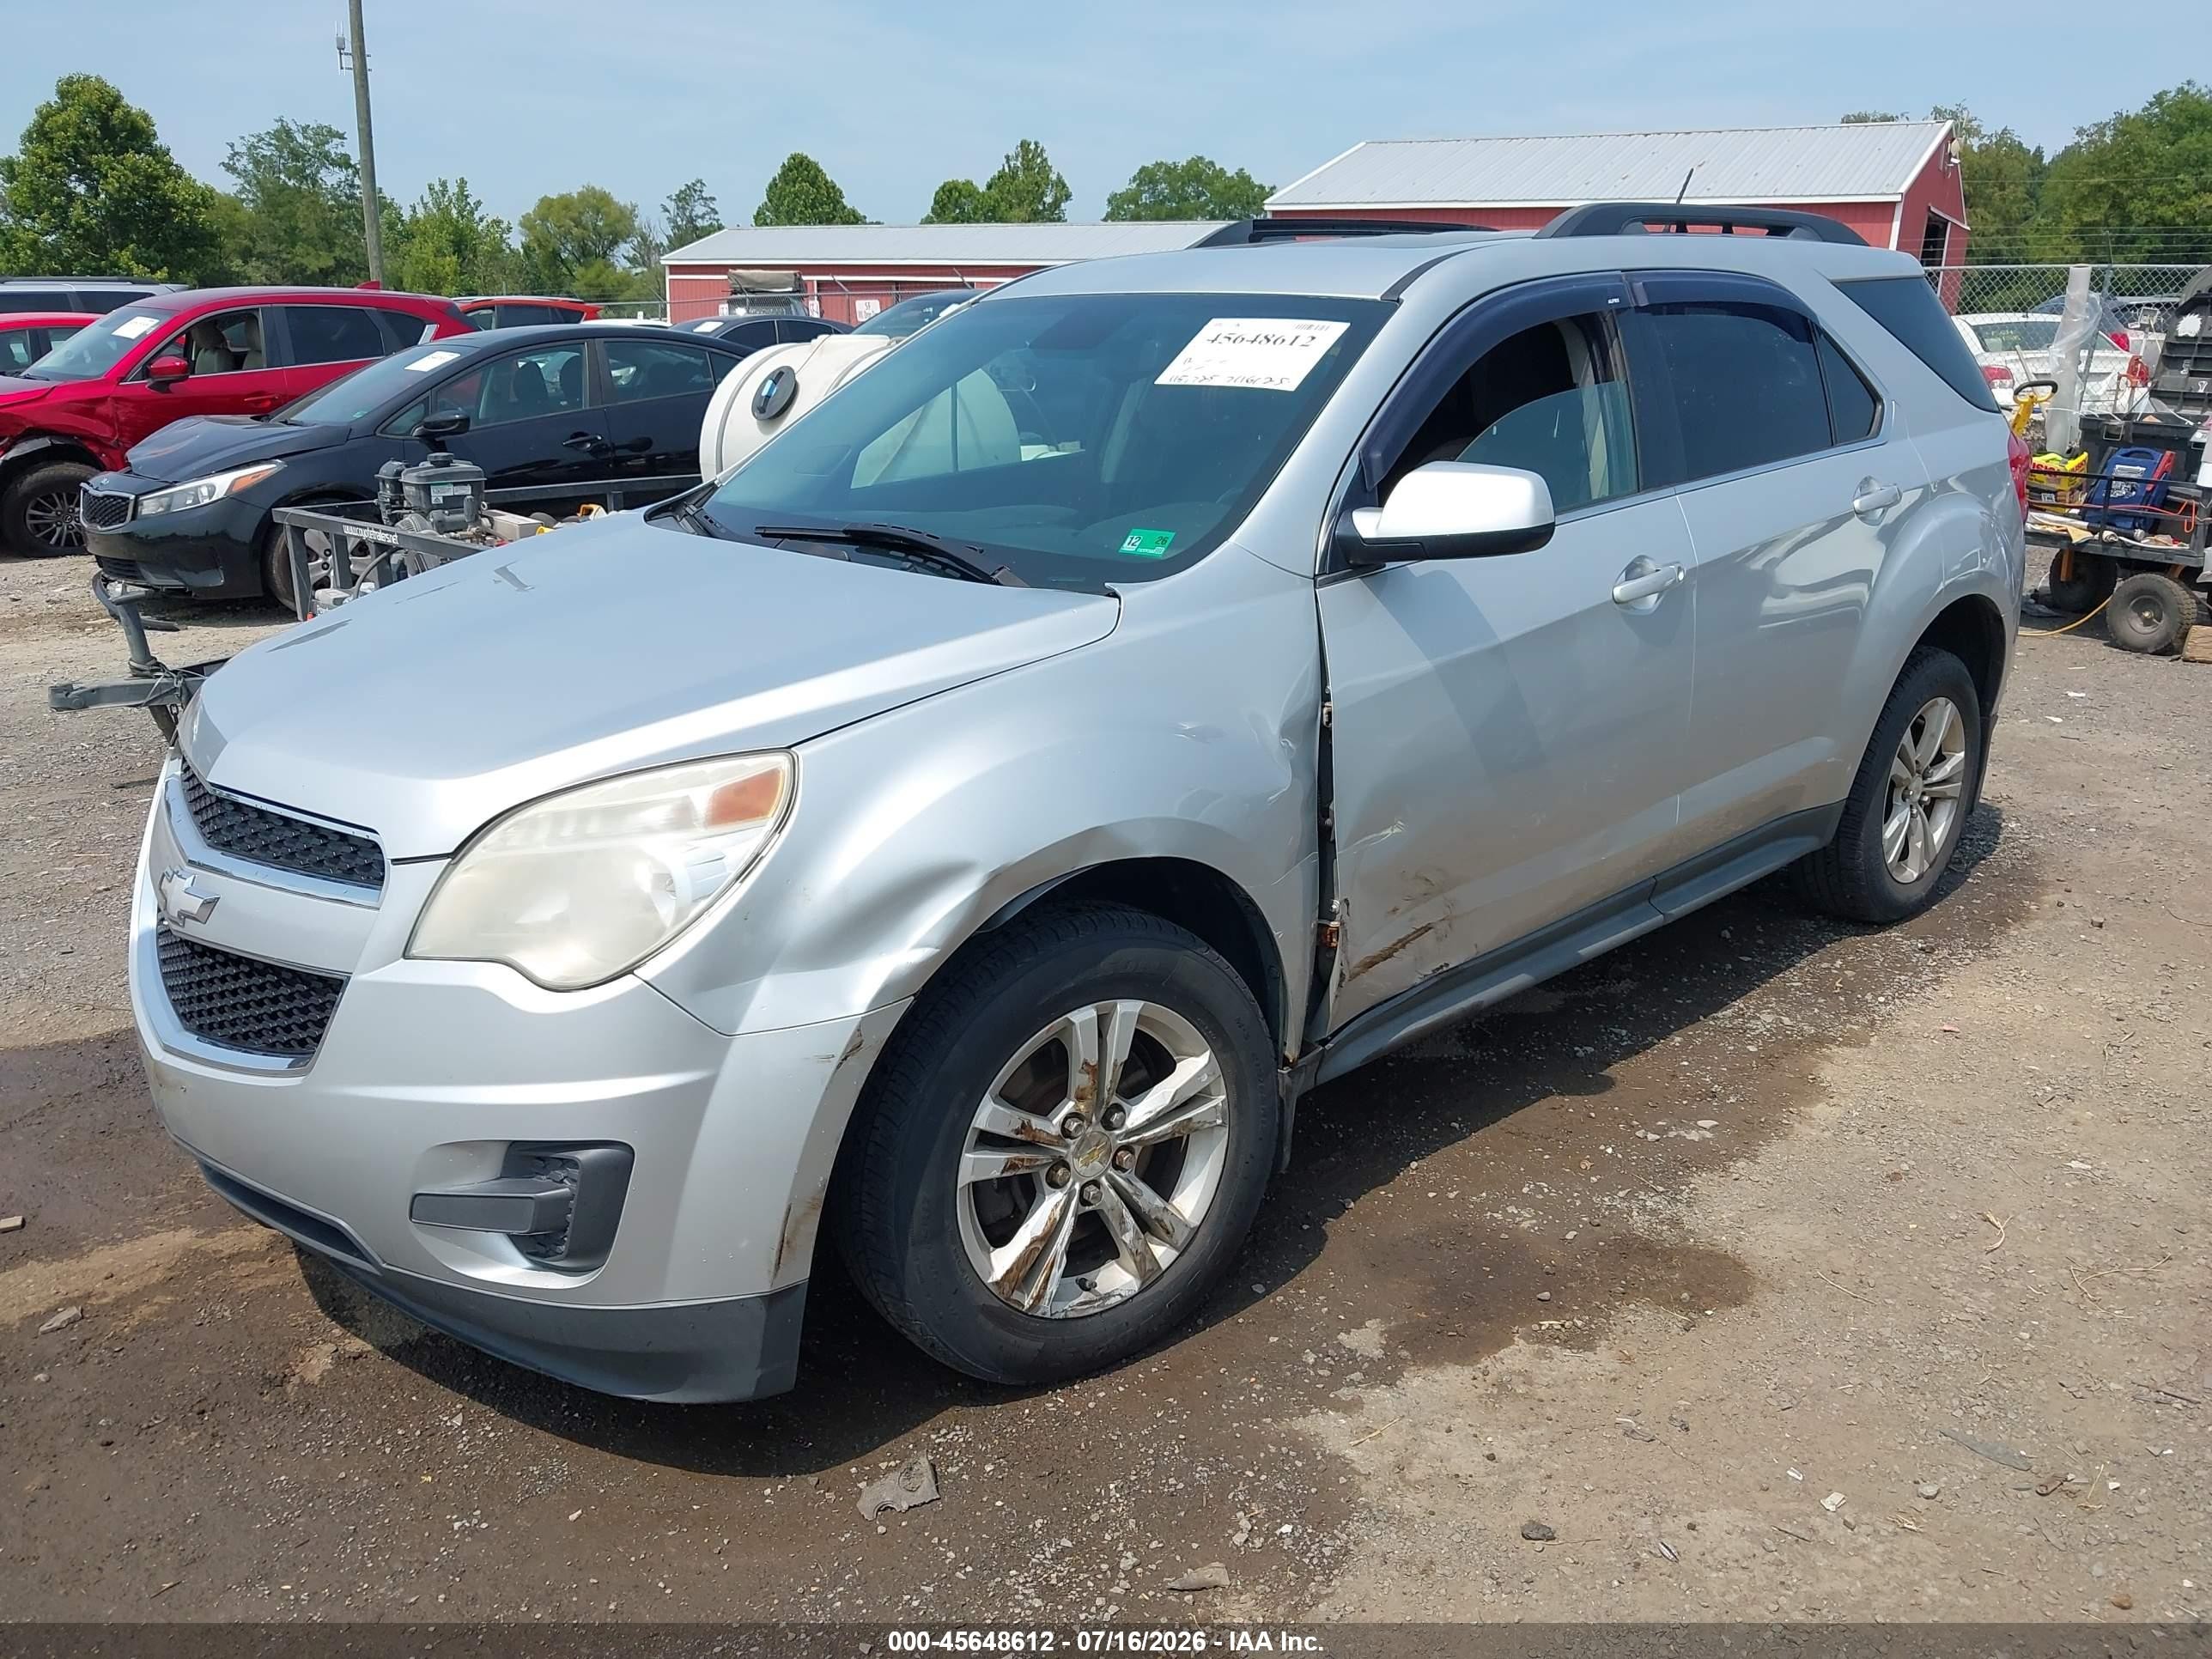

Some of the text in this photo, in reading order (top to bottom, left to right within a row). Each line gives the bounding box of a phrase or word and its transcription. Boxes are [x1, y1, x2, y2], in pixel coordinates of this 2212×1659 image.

[1206, 332, 1316, 347] 45648612
[1127, 536, 1169, 547] 12 26
